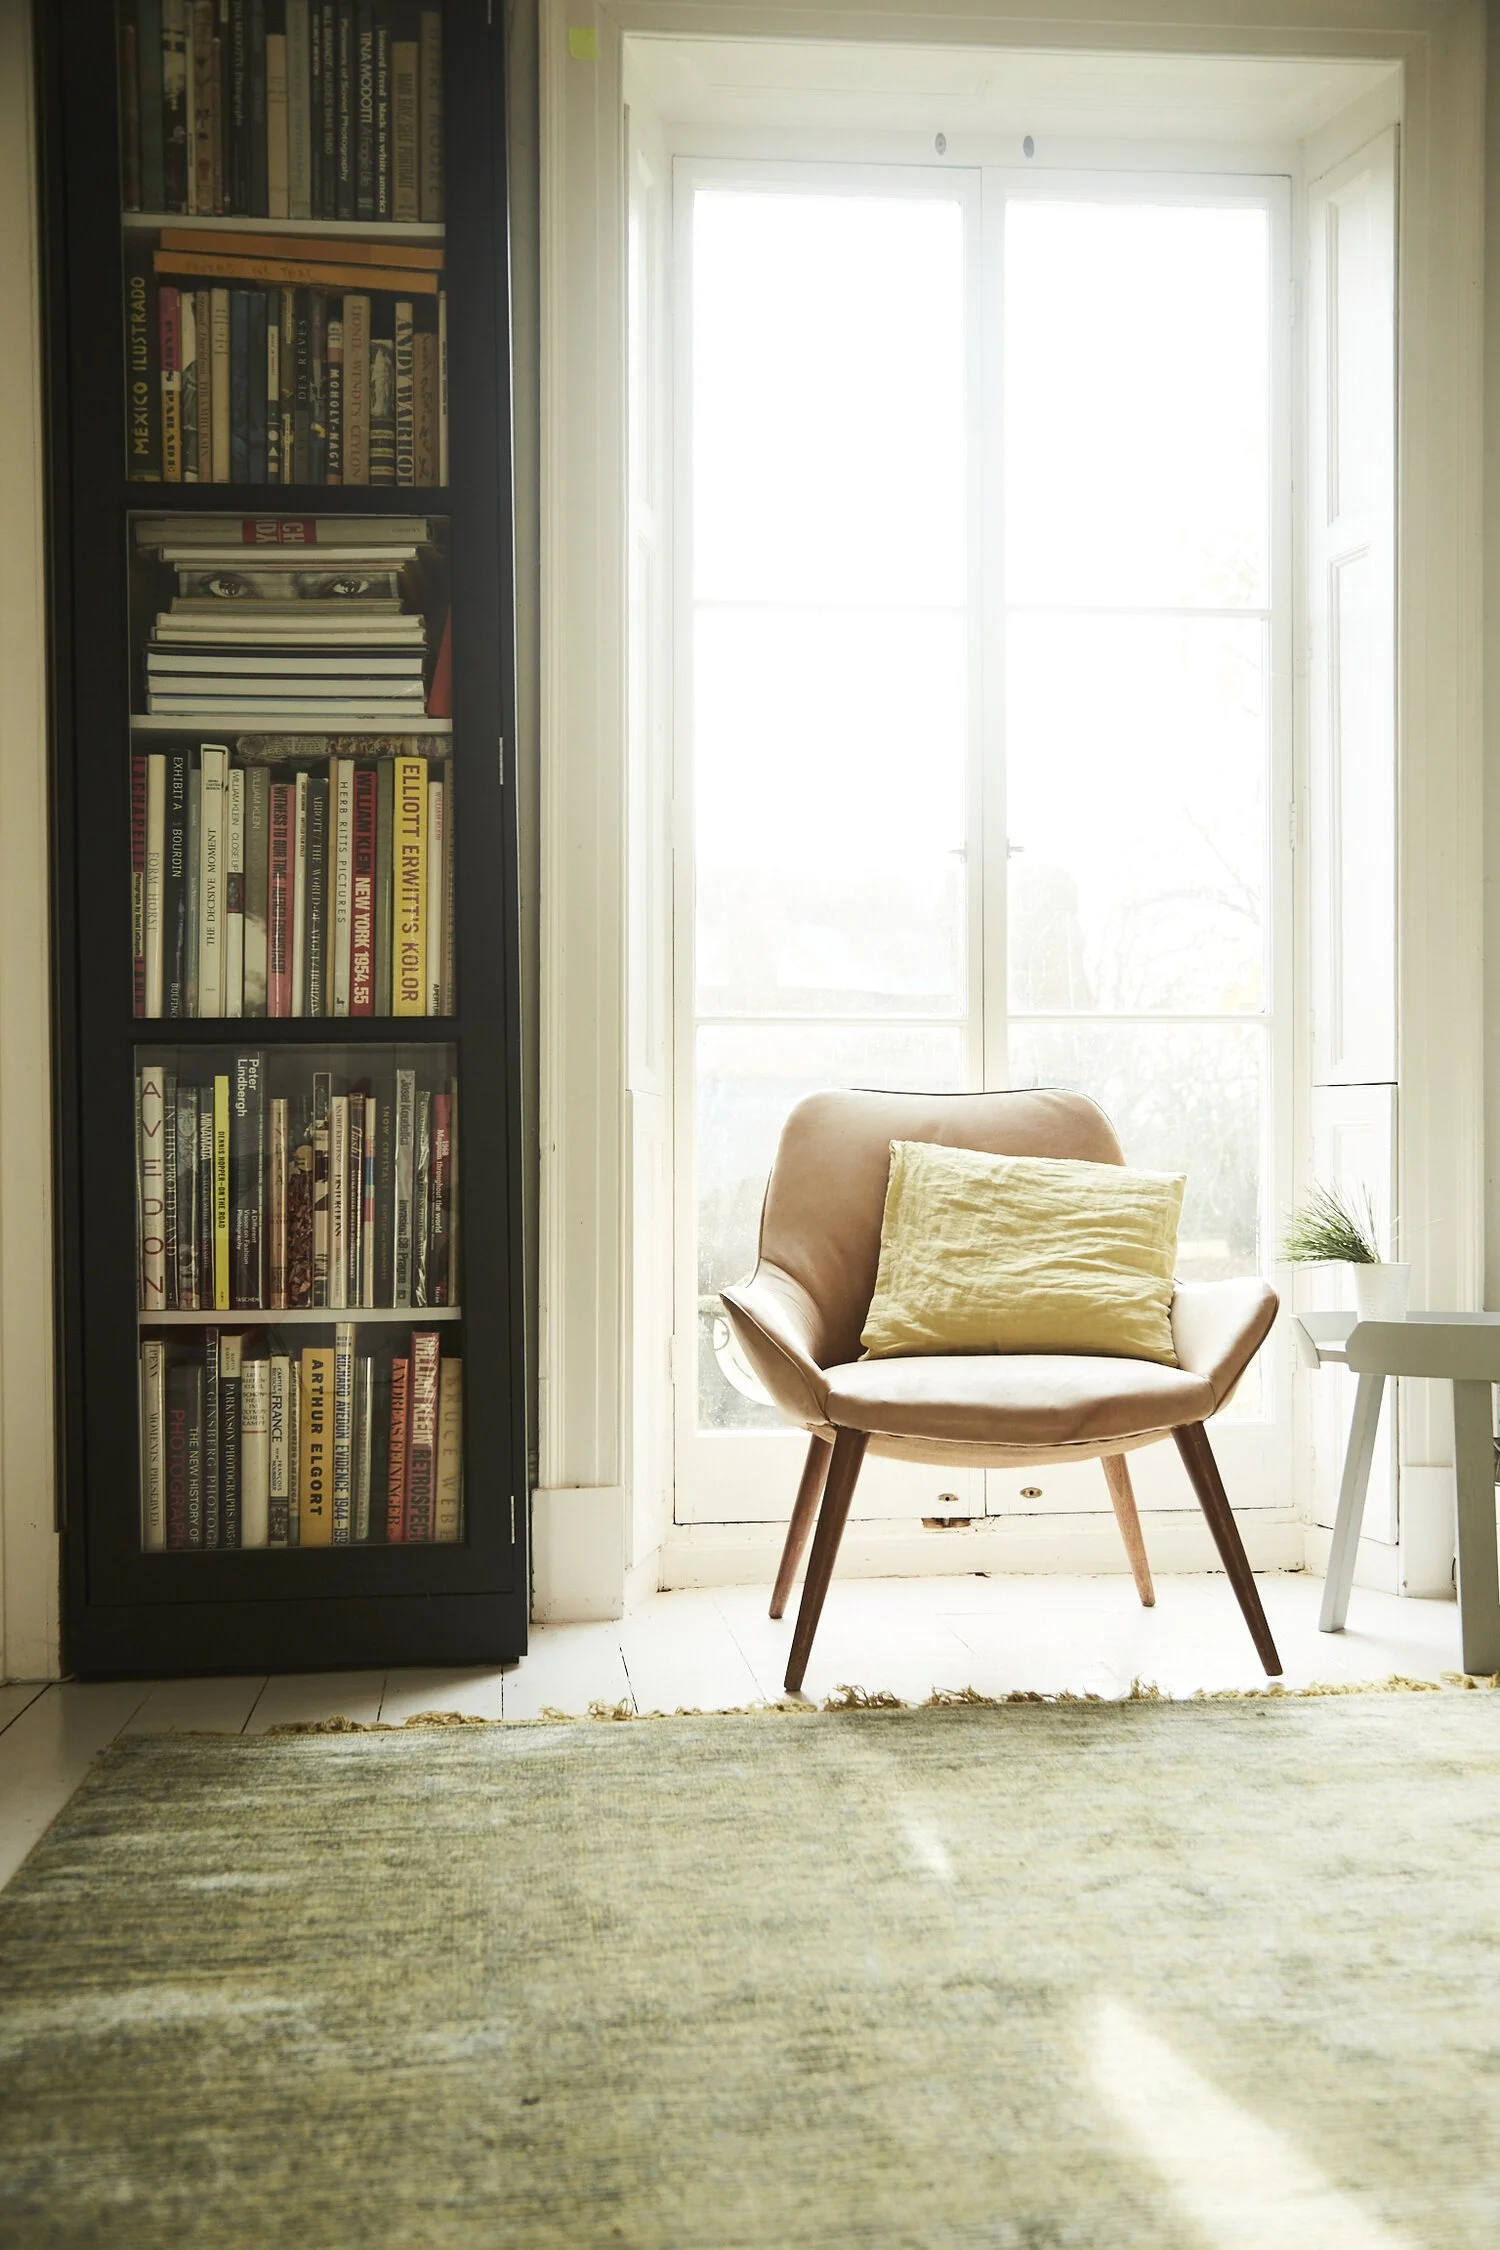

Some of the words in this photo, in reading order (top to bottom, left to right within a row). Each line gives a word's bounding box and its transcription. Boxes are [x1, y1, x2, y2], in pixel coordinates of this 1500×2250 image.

[359, 31, 373, 61] TINA
[429, 28, 444, 101] HENRY
[359, 63, 373, 125] MODOTTI
[377, 70, 388, 97] freed
[397, 73, 414, 95] MAN
[377, 102, 388, 129] black
[338, 115, 350, 182] Photography
[377, 145, 388, 173] white
[397, 146, 414, 189] PORTRAIT
[429, 113, 444, 196] MOORE
[377, 175, 388, 214] america
[130, 276, 148, 371] ILUSTRADO
[350, 305, 362, 353] LIONEL
[396, 315, 413, 378] ANDY
[297, 373, 309, 400] DES
[131, 381, 149, 455] MEXICO
[165, 390, 175, 473] PARADE
[328, 368, 341, 470] MOHOLY-NAGY
[350, 425, 362, 478] CEYLON
[172, 756, 183, 801] EXHIBIT
[231, 770, 240, 803] WILLIAM
[251, 770, 261, 804] WILLIAM
[338, 781, 348, 815] HERB
[172, 802, 183, 811] A
[231, 803, 240, 827] KLEIN
[251, 805, 261, 830] KLEIN
[272, 786, 289, 827] WITNESS
[355, 773, 373, 834] WILLIAM
[402, 764, 420, 838] ELLIOTT
[207, 828, 216, 873] MOMENT
[231, 832, 240, 858] CLOSE
[272, 828, 289, 838] TO
[272, 839, 289, 857] OUR
[338, 821, 348, 854] RITTS
[147, 852, 160, 885] FORM
[171, 829, 182, 879] BOURDIN
[231, 858, 240, 872] UP
[312, 843, 323, 865] THE
[355, 836, 373, 876] KLEIN
[134, 872, 143, 905] Photographs
[207, 879, 216, 922] DECISIVE
[312, 868, 323, 905] WORLD
[338, 860, 348, 924] PICTURES
[354, 877, 371, 912] NEW
[402, 845, 420, 934] ERWITT'S
[134, 914, 143, 928] David
[147, 893, 160, 932] HORST
[311, 909, 321, 921] OF
[354, 912, 371, 948] YORK
[207, 927, 216, 947] THE
[353, 950, 370, 1004] 1954.55
[401, 942, 419, 1002] KOLOR
[432, 983, 440, 1016] APERTUR
[235, 1058, 248, 1117] Lindbergh
[249, 1058, 260, 1090] Peter
[164, 1104, 176, 1121] IN
[382, 1105, 390, 1135] SNOW
[400, 1104, 412, 1146] Koudelka
[164, 1126, 176, 1160] THIS
[200, 1112, 213, 1160] MINAMATA
[217, 1131, 225, 1155] DENNIS
[435, 1129, 445, 1160] Magnum
[442, 1140, 450, 1157] 1968
[382, 1141, 390, 1189] CRYSTALS
[434, 1161, 444, 1197] throughout
[142, 1081, 163, 1294] AVEDON
[164, 1162, 176, 1211] PROUD
[217, 1197, 225, 1209] THE
[334, 1174, 342, 1238] DISTORTIONS
[435, 1200, 445, 1211] the
[164, 1213, 176, 1257] LAND
[217, 1211, 225, 1229] ROAD
[235, 1209, 243, 1250] Photography
[399, 1199, 409, 1236] Invasion
[435, 1212, 445, 1234] world
[397, 1252, 409, 1284] Prague
[149, 1349, 159, 1379] PENN
[206, 1340, 217, 1384] ALLEN
[336, 1354, 351, 1397] RICHARD
[414, 1336, 438, 1399] WILLIAM
[225, 1383, 236, 1441] PARKINSON
[311, 1359, 323, 1434] ARTHUR
[391, 1362, 406, 1436] ANDREAS
[149, 1411, 159, 1463] MOMENTS
[188, 1426, 199, 1447] THE
[206, 1391, 217, 1467] GINSBERG
[271, 1395, 283, 1443] FRANCE
[335, 1400, 350, 1439] AVEDON
[412, 1402, 436, 1445] KLEIN
[443, 1377, 460, 1457] BRUCE
[188, 1450, 199, 1476] NEW
[225, 1444, 236, 1517] PHOTOGRAPHS
[311, 1443, 323, 1516] ELGORT
[334, 1444, 350, 1493] EVIDENCE
[387, 1440, 404, 1525] FEININGER
[149, 1467, 159, 1527] PRESERVED
[188, 1479, 199, 1526] HISTORY
[188, 1528, 199, 1543] OF
